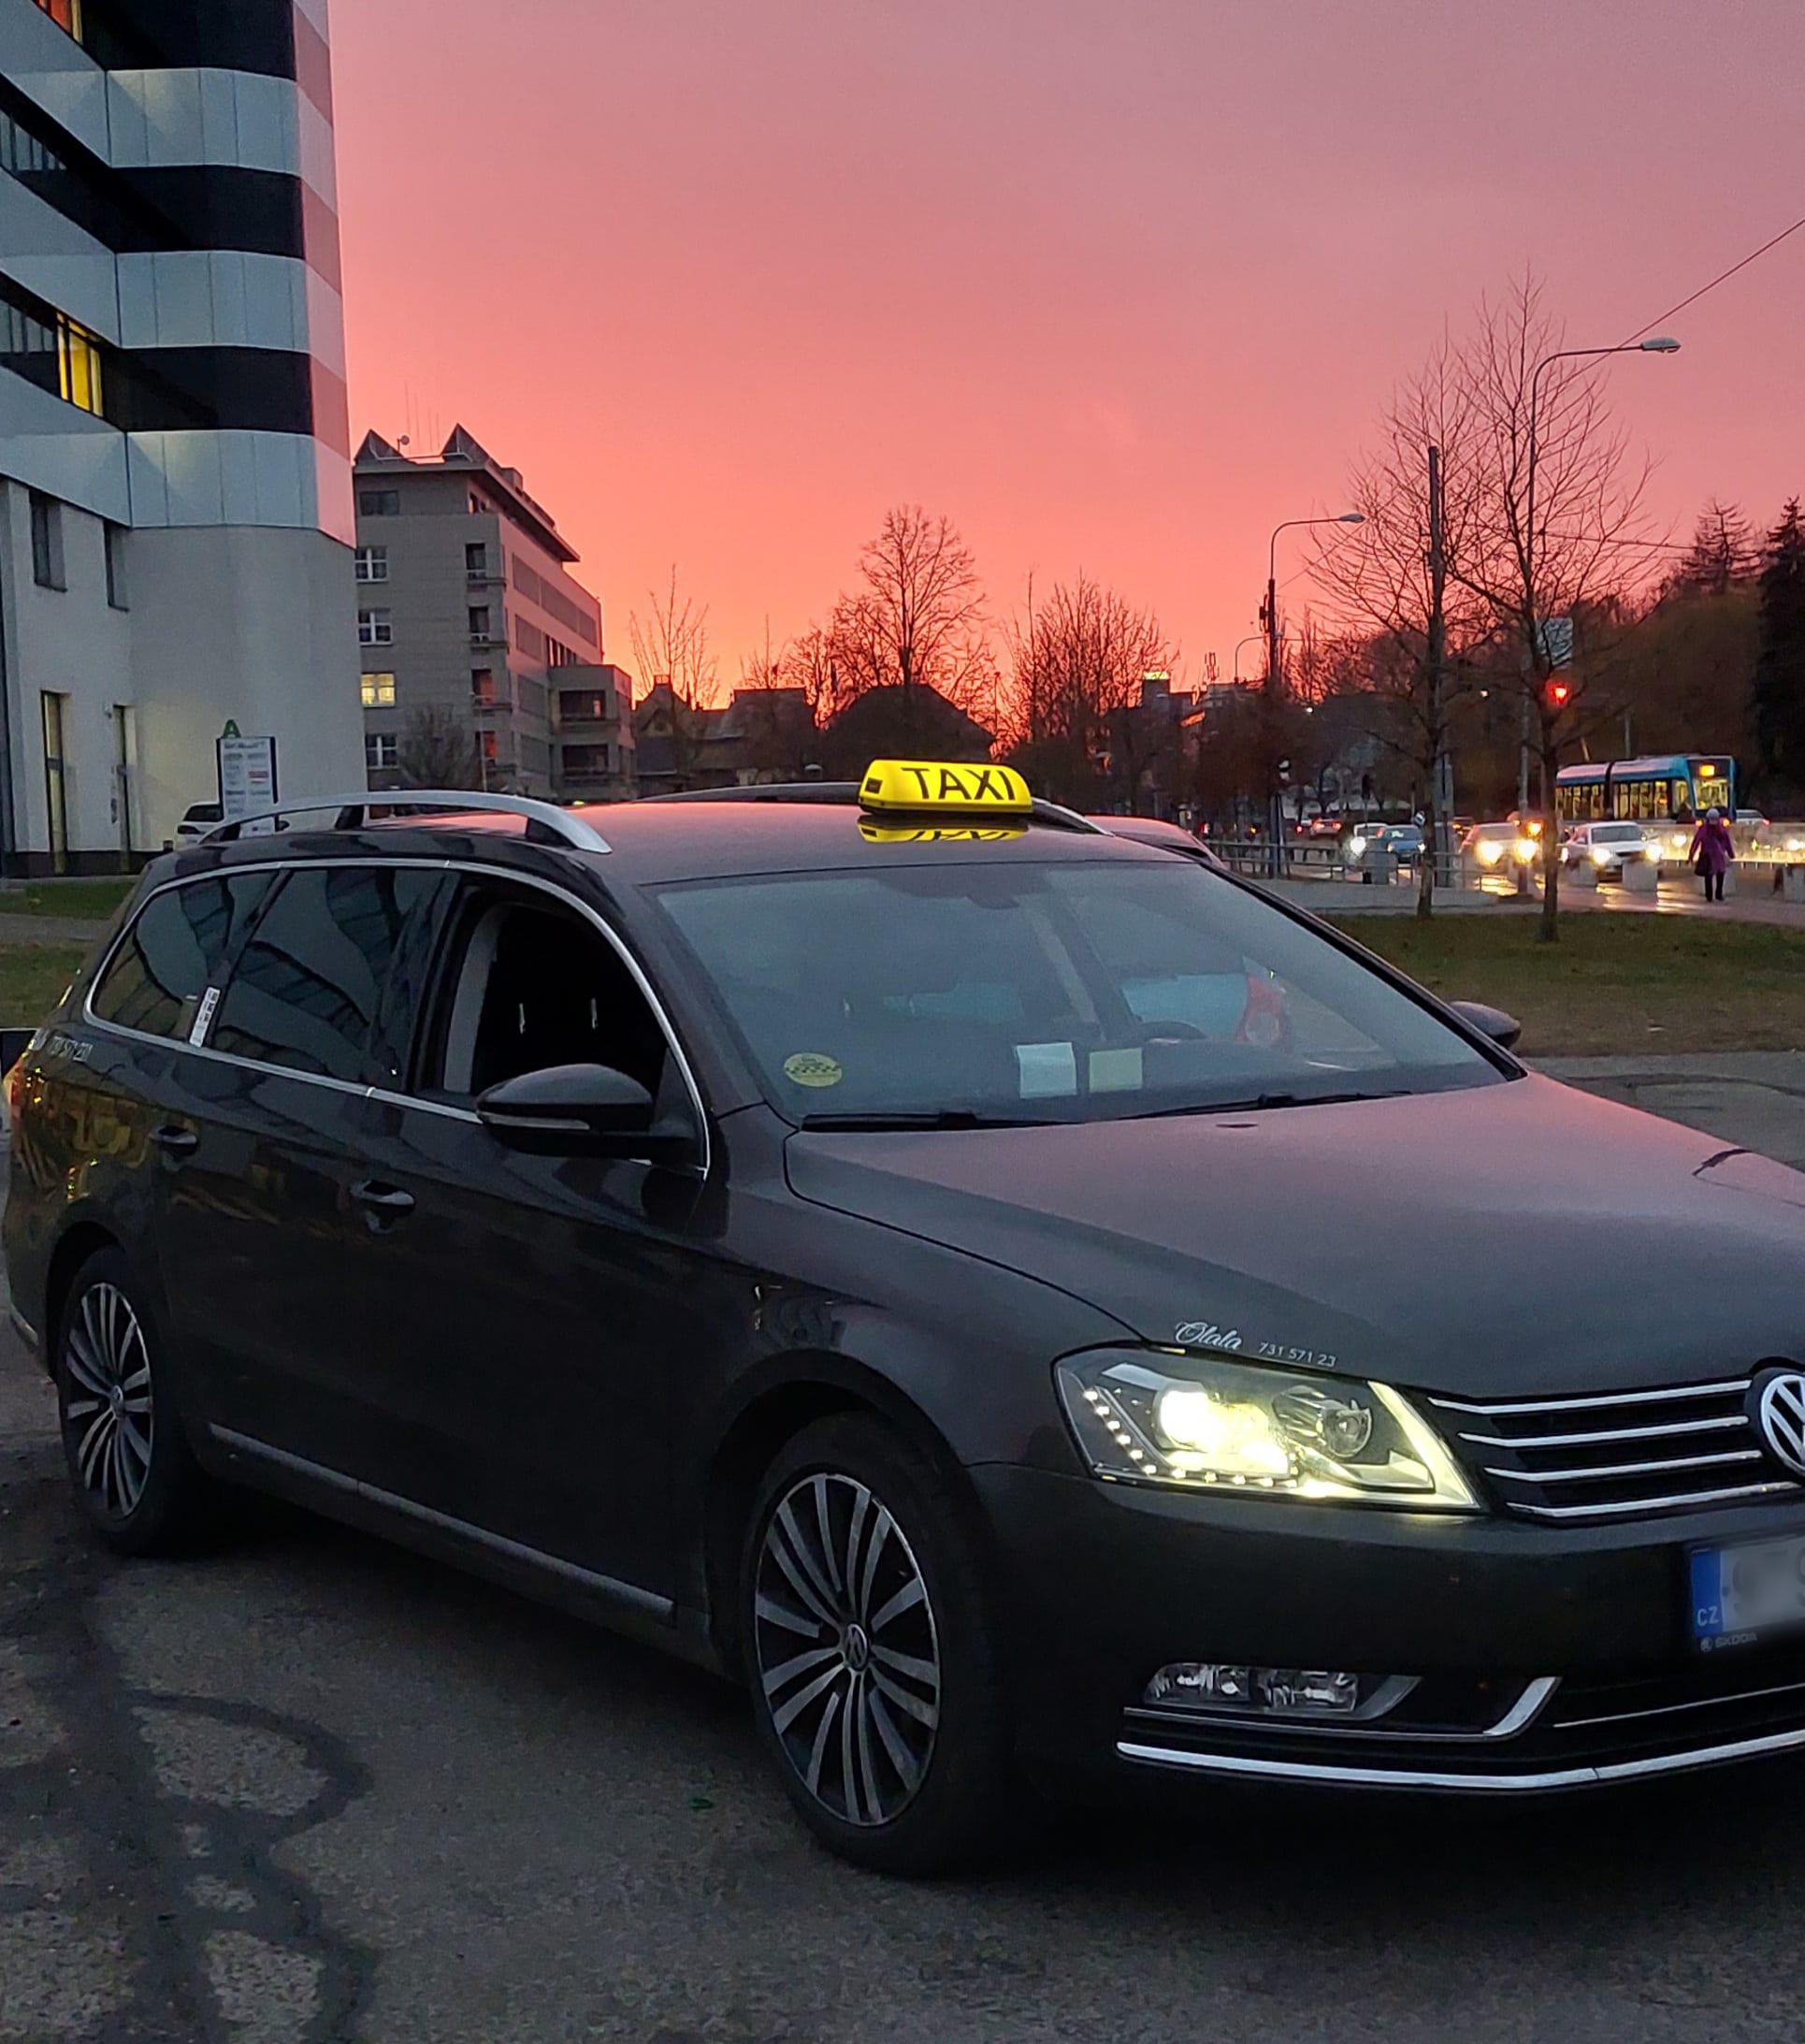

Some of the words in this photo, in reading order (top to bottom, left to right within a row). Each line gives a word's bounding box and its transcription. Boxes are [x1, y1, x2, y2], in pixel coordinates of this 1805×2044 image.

[902, 767, 1016, 801] TAXI
[1175, 1321, 1242, 1351] Olala
[1259, 1341, 1284, 1356] 731
[1289, 1348, 1313, 1363] 571
[1697, 1606, 1720, 1627] CZ
